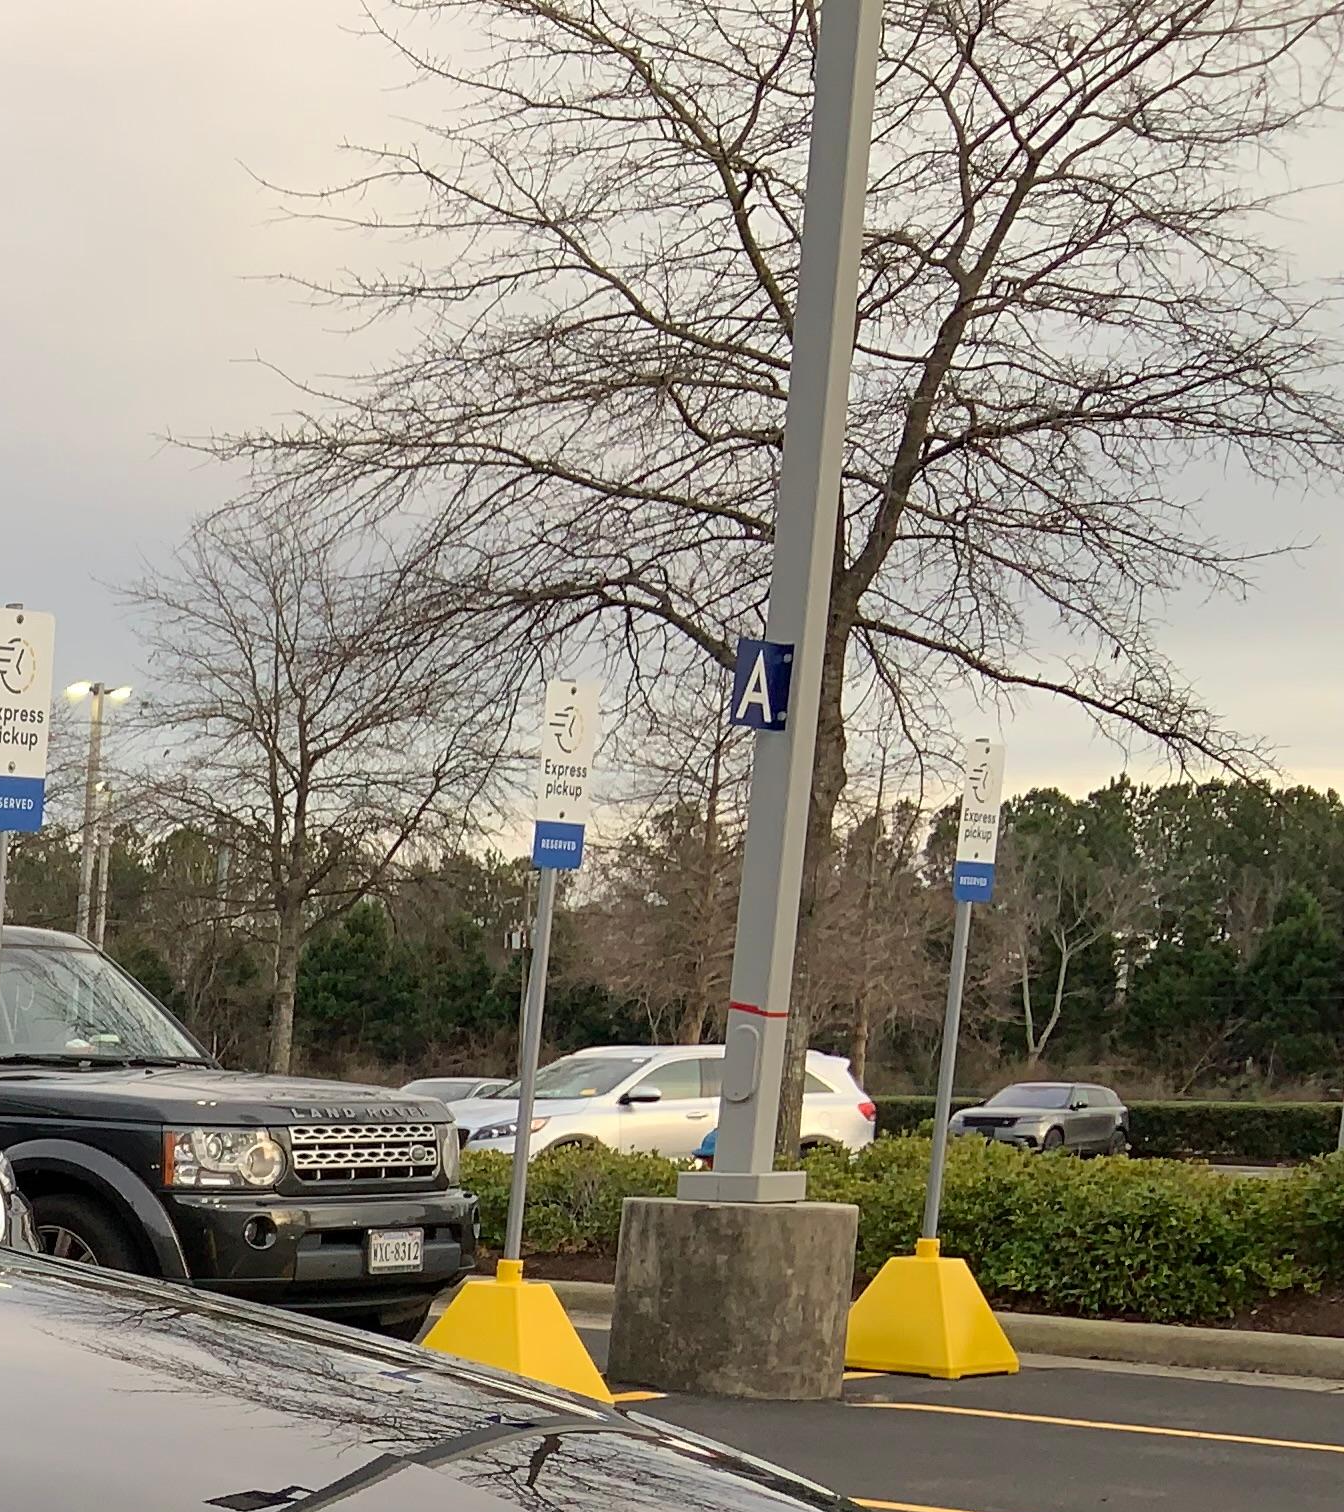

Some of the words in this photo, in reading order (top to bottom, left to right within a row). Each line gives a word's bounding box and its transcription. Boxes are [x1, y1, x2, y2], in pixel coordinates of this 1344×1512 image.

[735, 649, 772, 723] A
[544, 759, 587, 781] Express
[545, 780, 583, 801] pickup
[964, 807, 996, 825] Express
[964, 826, 992, 844] pickup
[291, 1107, 356, 1120] LAND
[366, 1105, 430, 1119] ROVER
